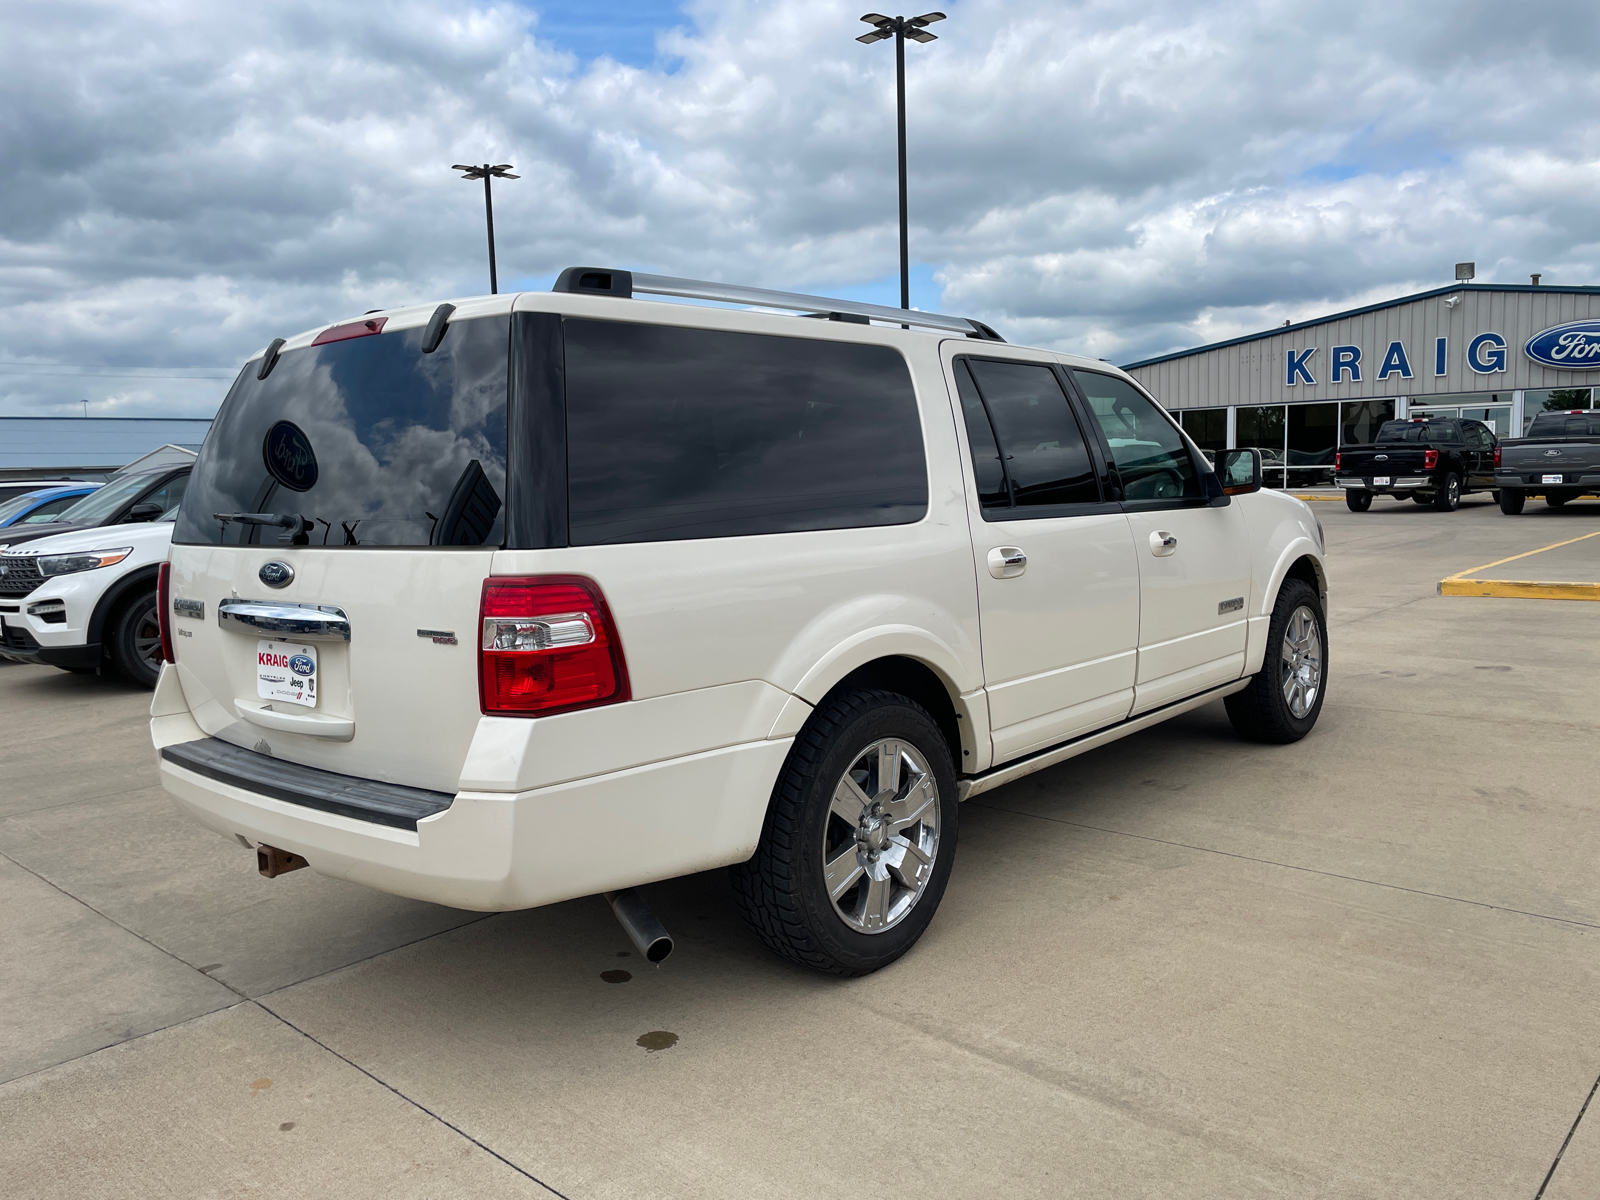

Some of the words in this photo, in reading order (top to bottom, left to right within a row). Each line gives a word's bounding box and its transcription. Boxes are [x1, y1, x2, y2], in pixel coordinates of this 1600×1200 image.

[1286, 331, 1507, 386] KRAIG
[1550, 331, 1600, 359] For
[263, 565, 282, 580] Ford
[258, 652, 289, 668] KRAIG
[294, 658, 311, 673] Ford
[290, 677, 304, 690] Jeep
